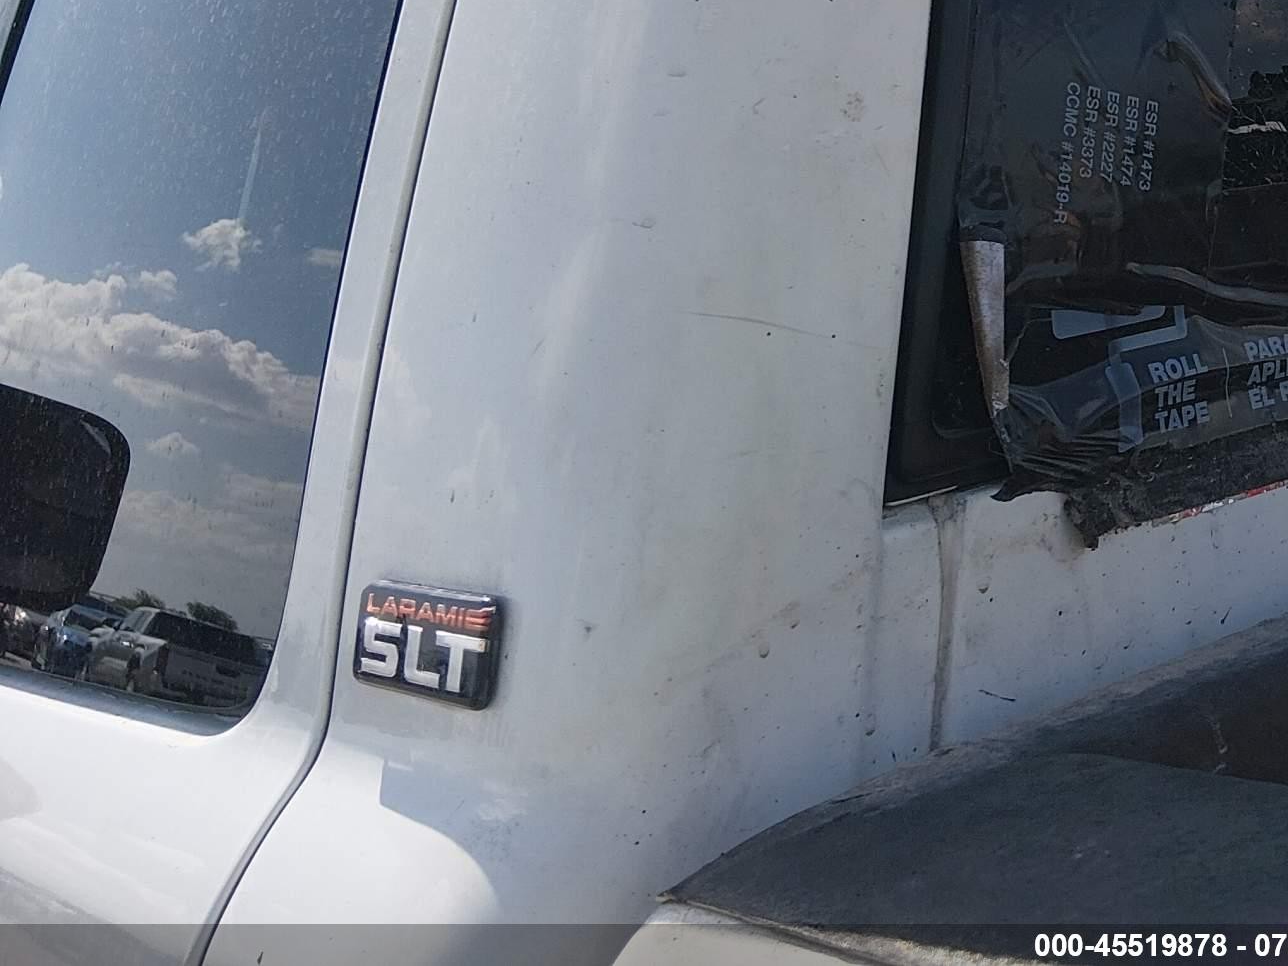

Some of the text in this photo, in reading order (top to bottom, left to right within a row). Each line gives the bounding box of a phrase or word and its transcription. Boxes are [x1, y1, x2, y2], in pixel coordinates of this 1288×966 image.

[1053, 82, 1080, 224] CCMC #14019-R
[1079, 85, 1101, 178] ESR #3373
[1099, 90, 1120, 183] ESR #2227
[1120, 95, 1139, 186] ESR #1474
[1139, 100, 1159, 192] ESR #1473
[1147, 353, 1208, 384] ROLL
[1154, 380, 1196, 408] THE
[1248, 385, 1275, 410] EL
[1154, 401, 1210, 433] TAPE
[366, 593, 496, 628] LARAMIE
[360, 616, 488, 693] SLT
